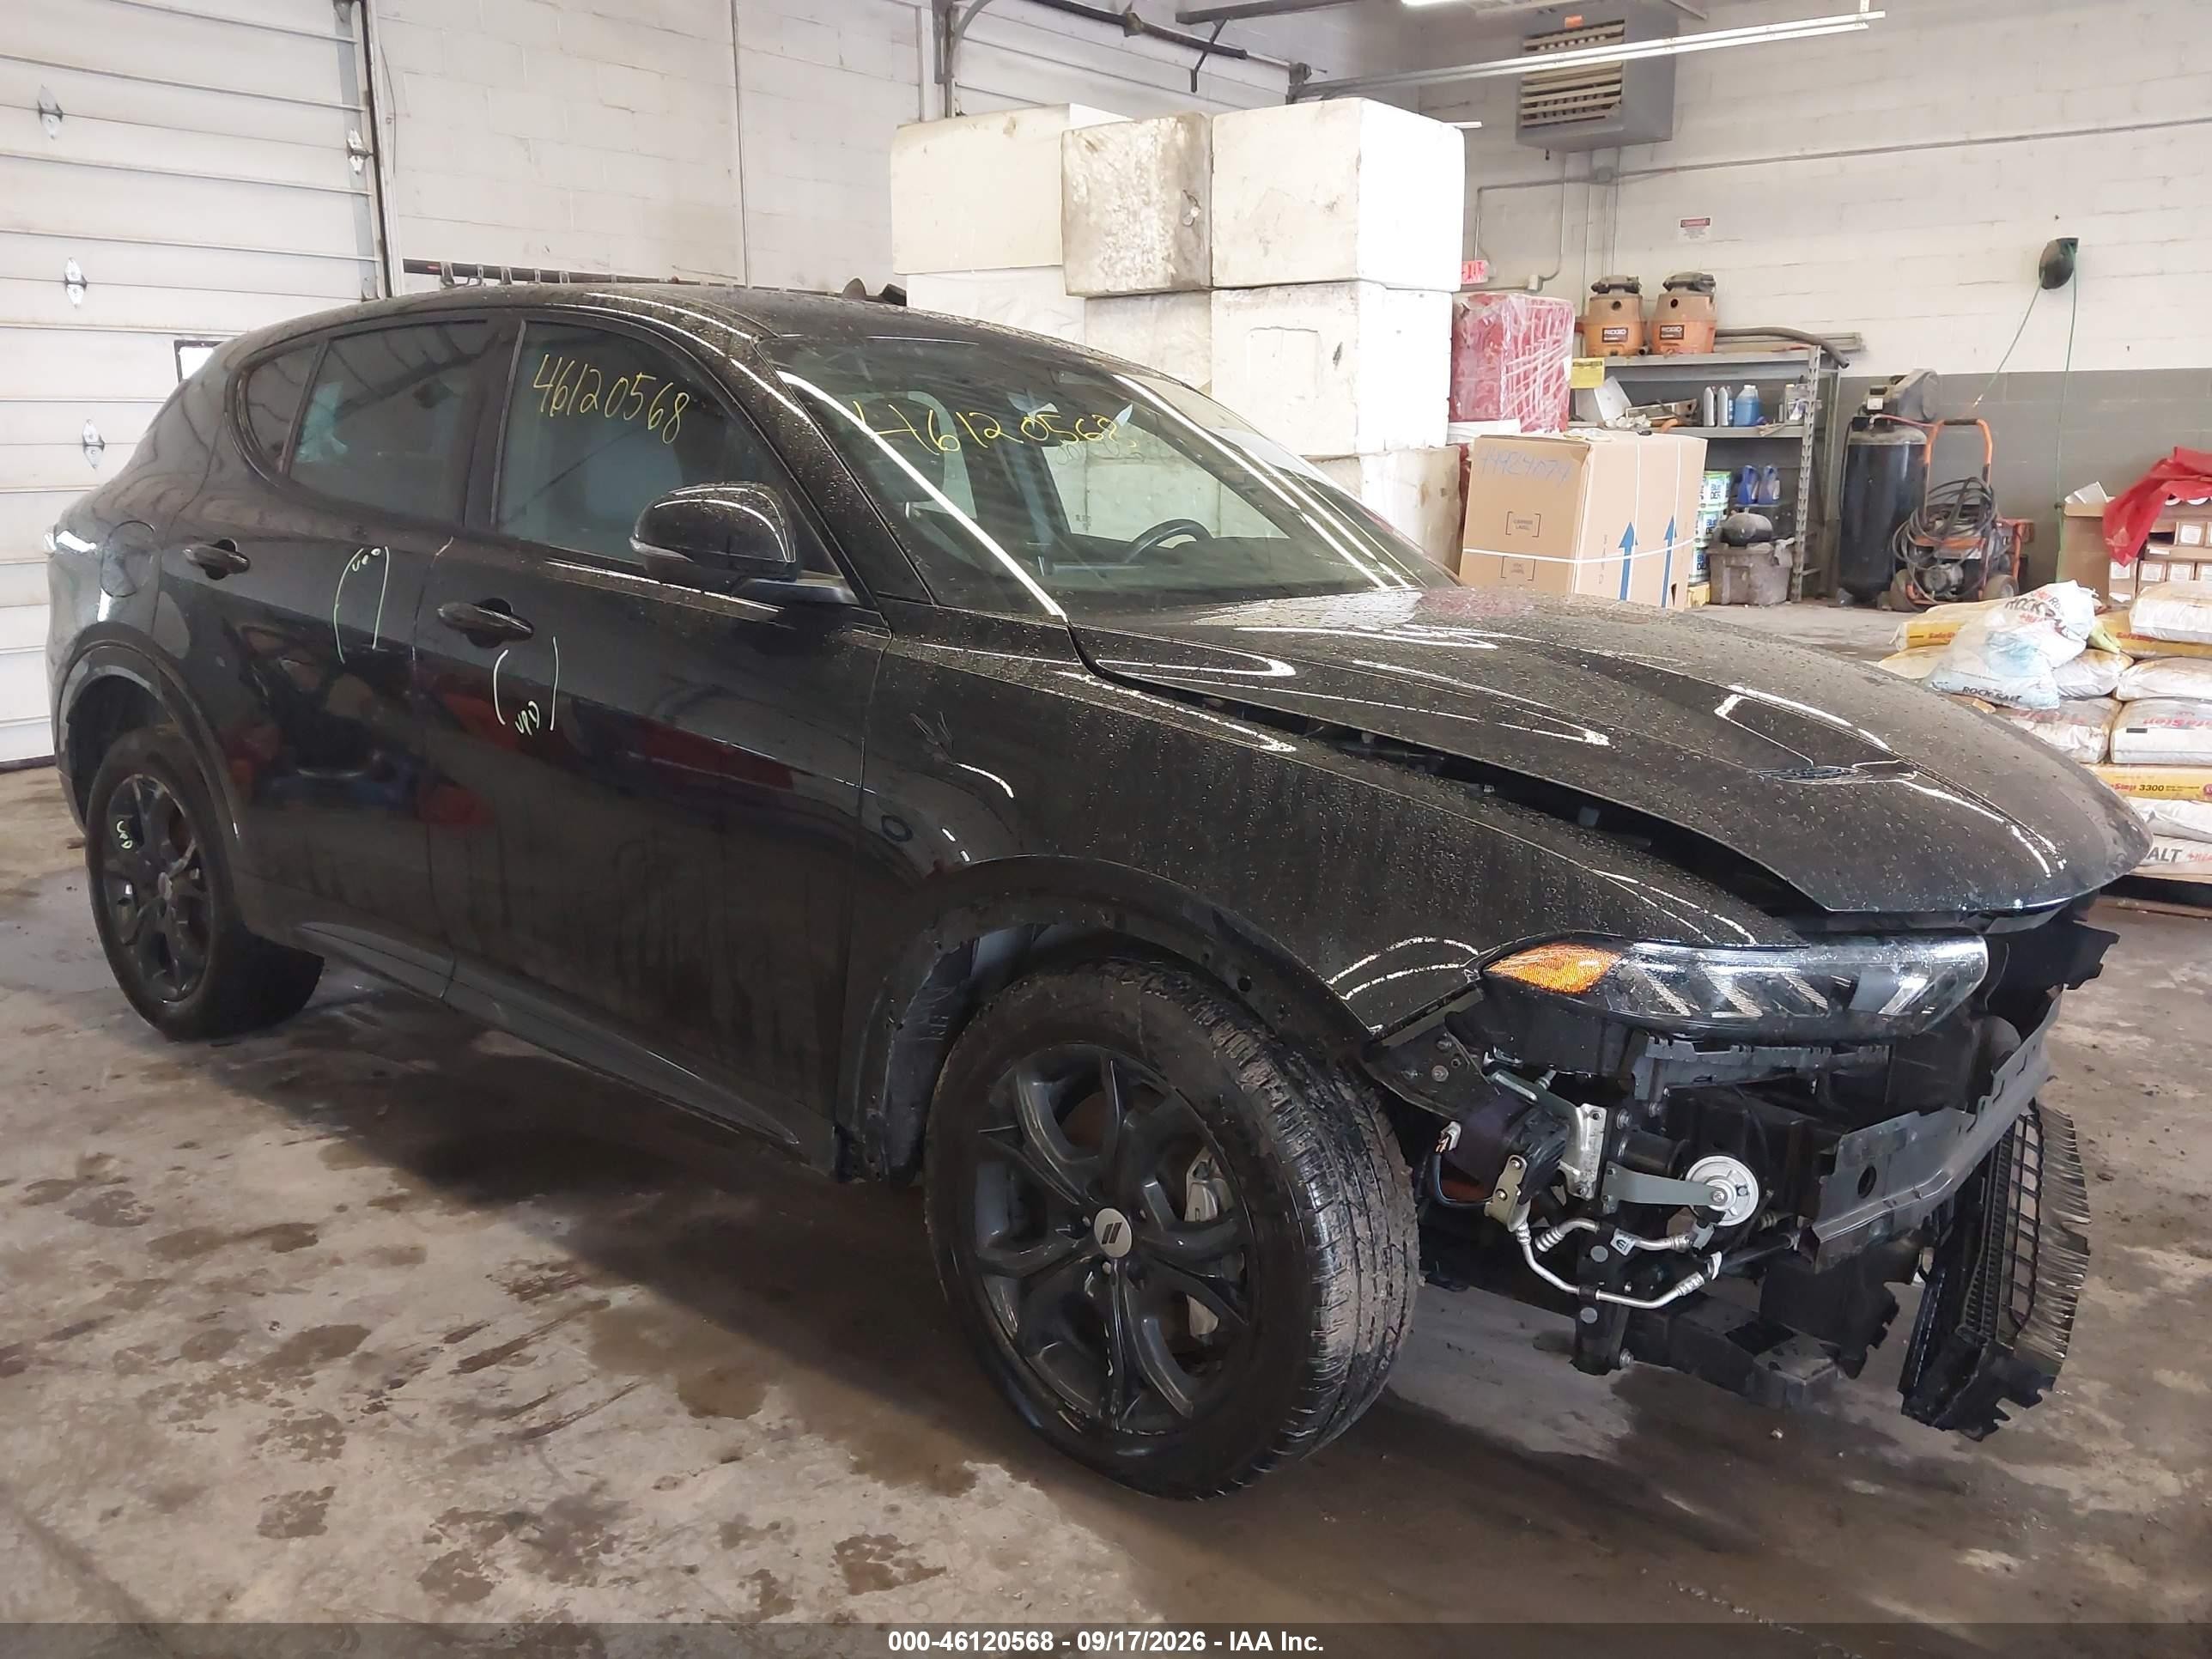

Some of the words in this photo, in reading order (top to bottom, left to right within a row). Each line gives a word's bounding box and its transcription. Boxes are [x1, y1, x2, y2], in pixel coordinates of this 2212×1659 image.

[533, 354, 690, 444] 46120568
[2139, 784, 2165, 793] 3300
[2147, 846, 2183, 864] ALT
